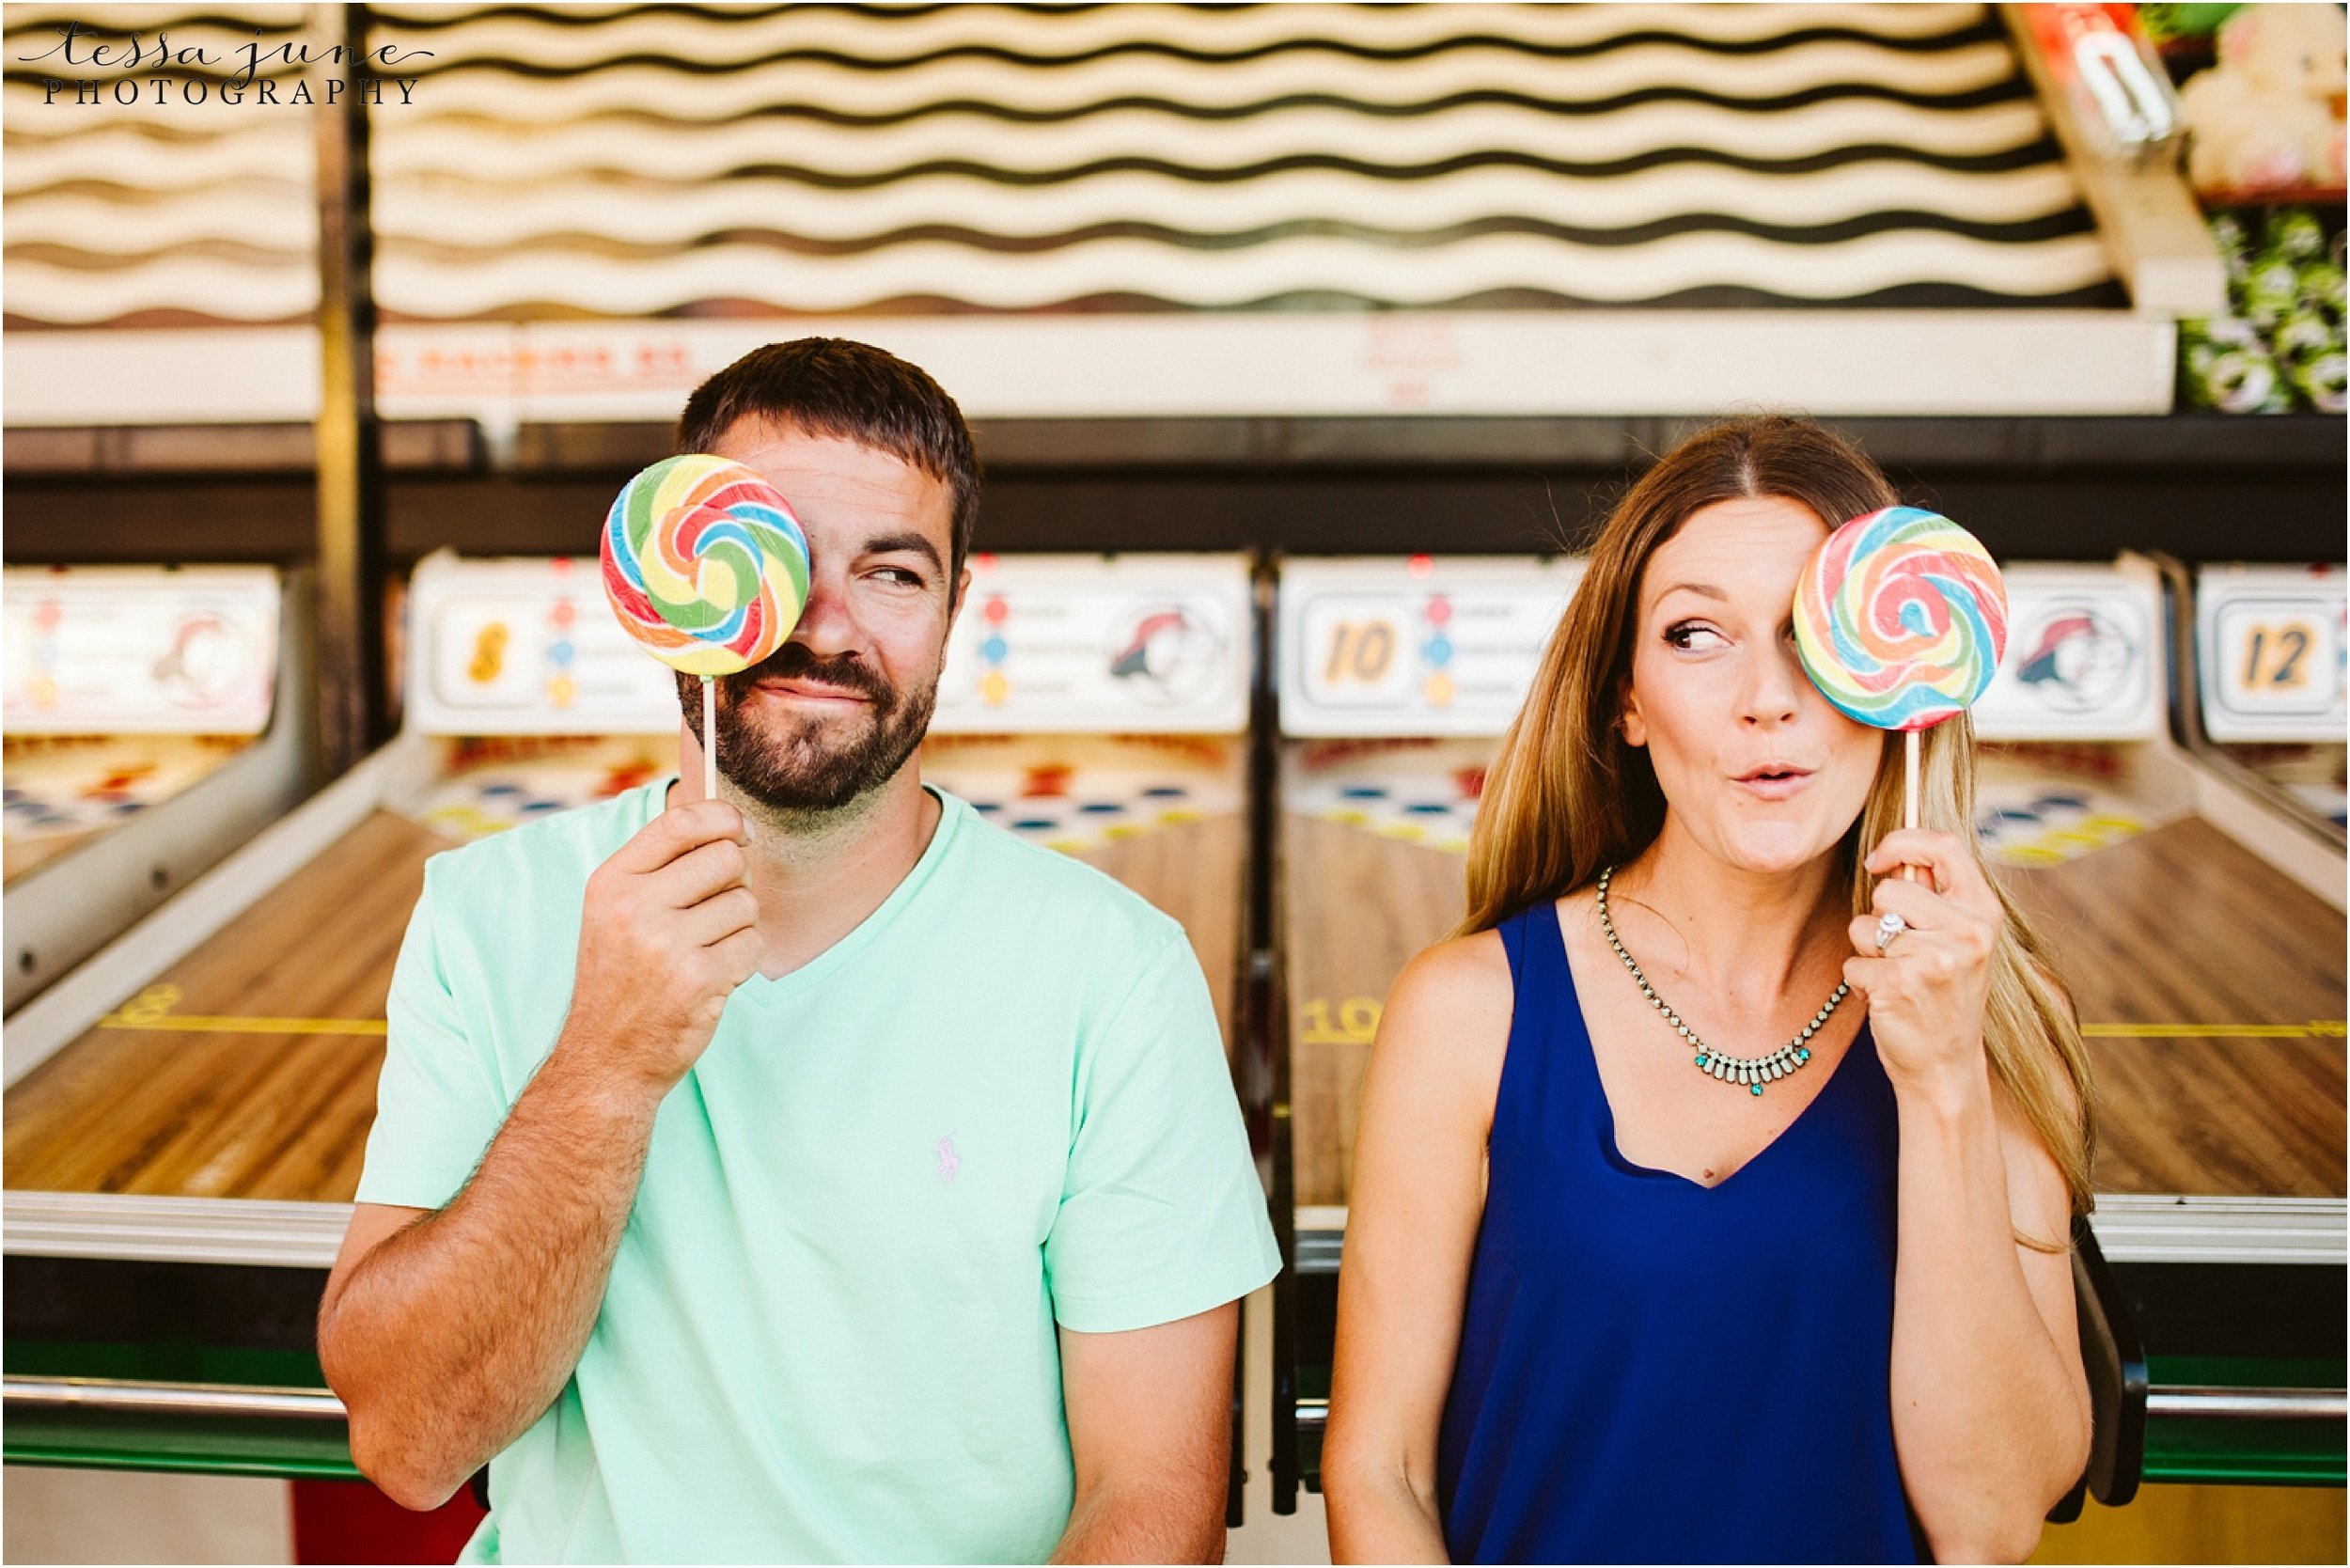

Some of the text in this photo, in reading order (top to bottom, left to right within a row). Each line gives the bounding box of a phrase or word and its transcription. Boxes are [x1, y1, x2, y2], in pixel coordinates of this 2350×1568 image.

[1324, 620, 1396, 683] 10
[2244, 622, 2316, 690] 12
[1301, 996, 1384, 1041] 10
